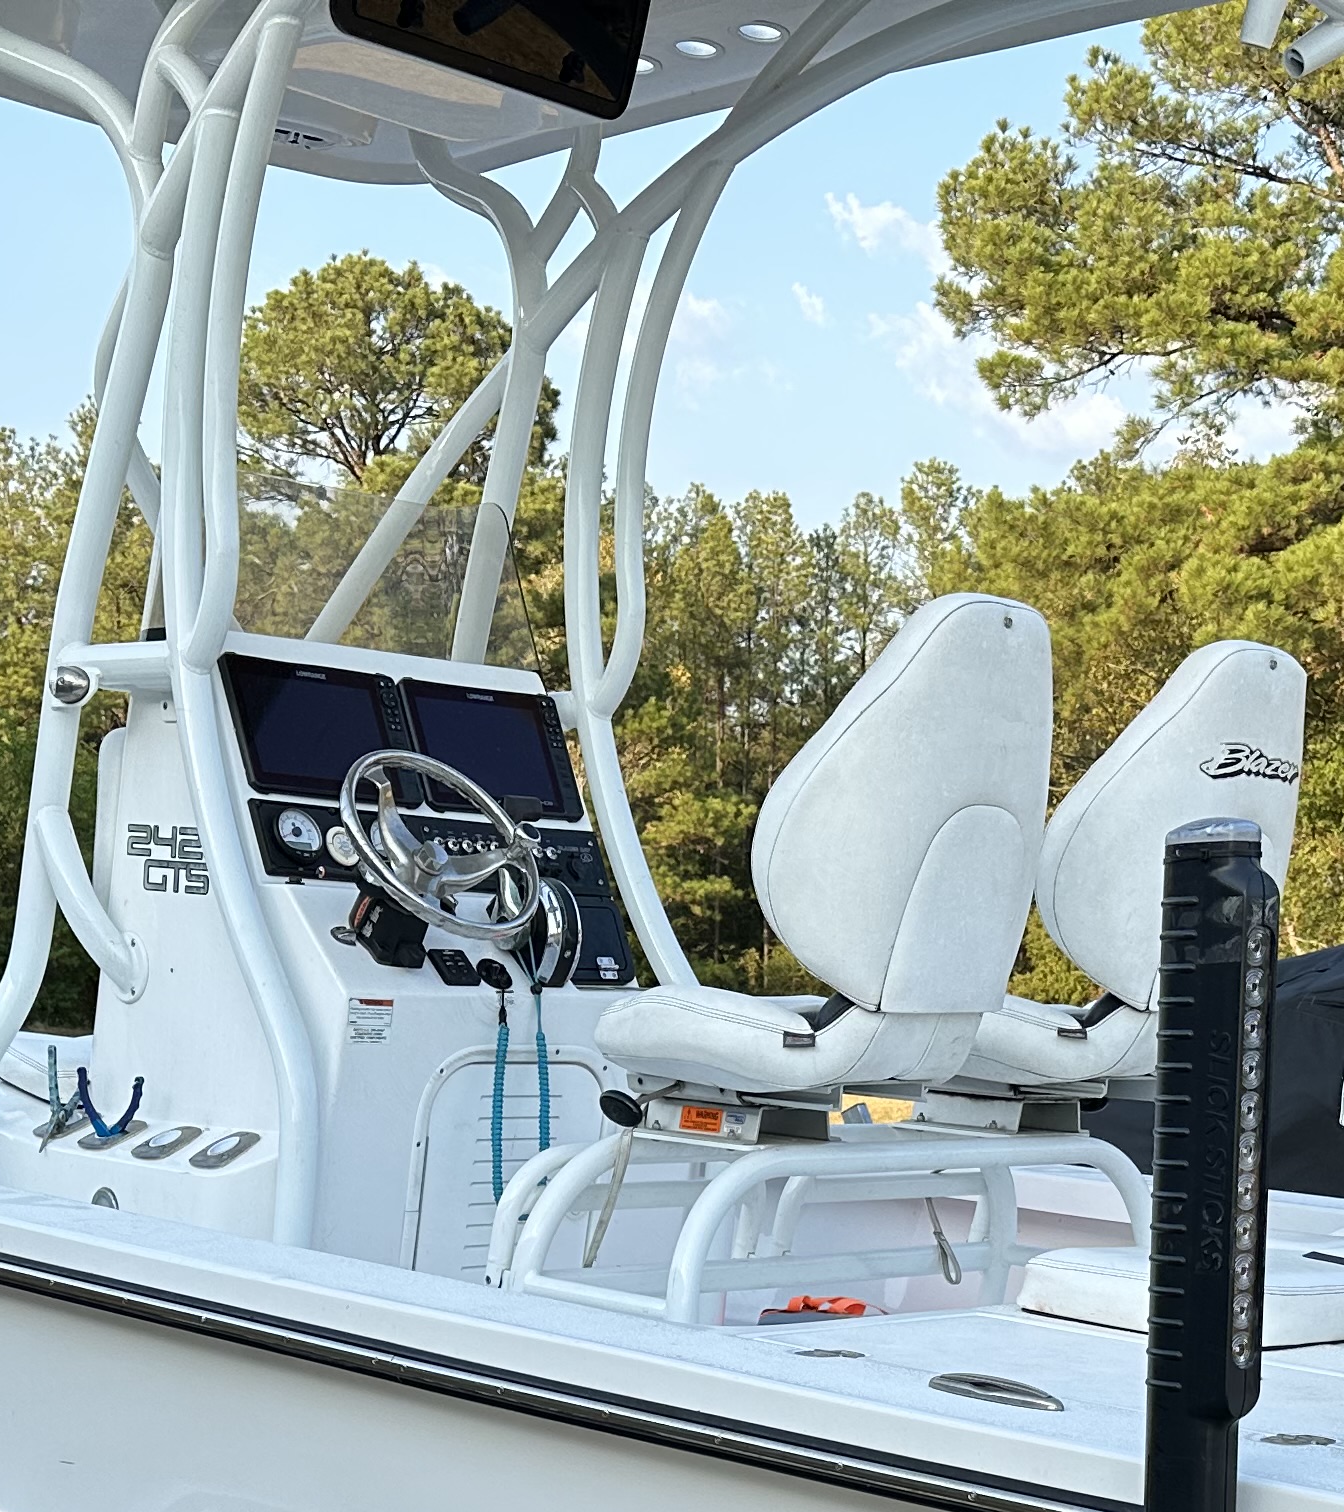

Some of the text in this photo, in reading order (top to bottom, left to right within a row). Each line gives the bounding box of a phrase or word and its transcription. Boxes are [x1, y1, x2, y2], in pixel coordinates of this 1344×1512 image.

[1199, 742, 1299, 785] Blazer
[127, 824, 203, 860] 242
[143, 859, 209, 895] GTS
